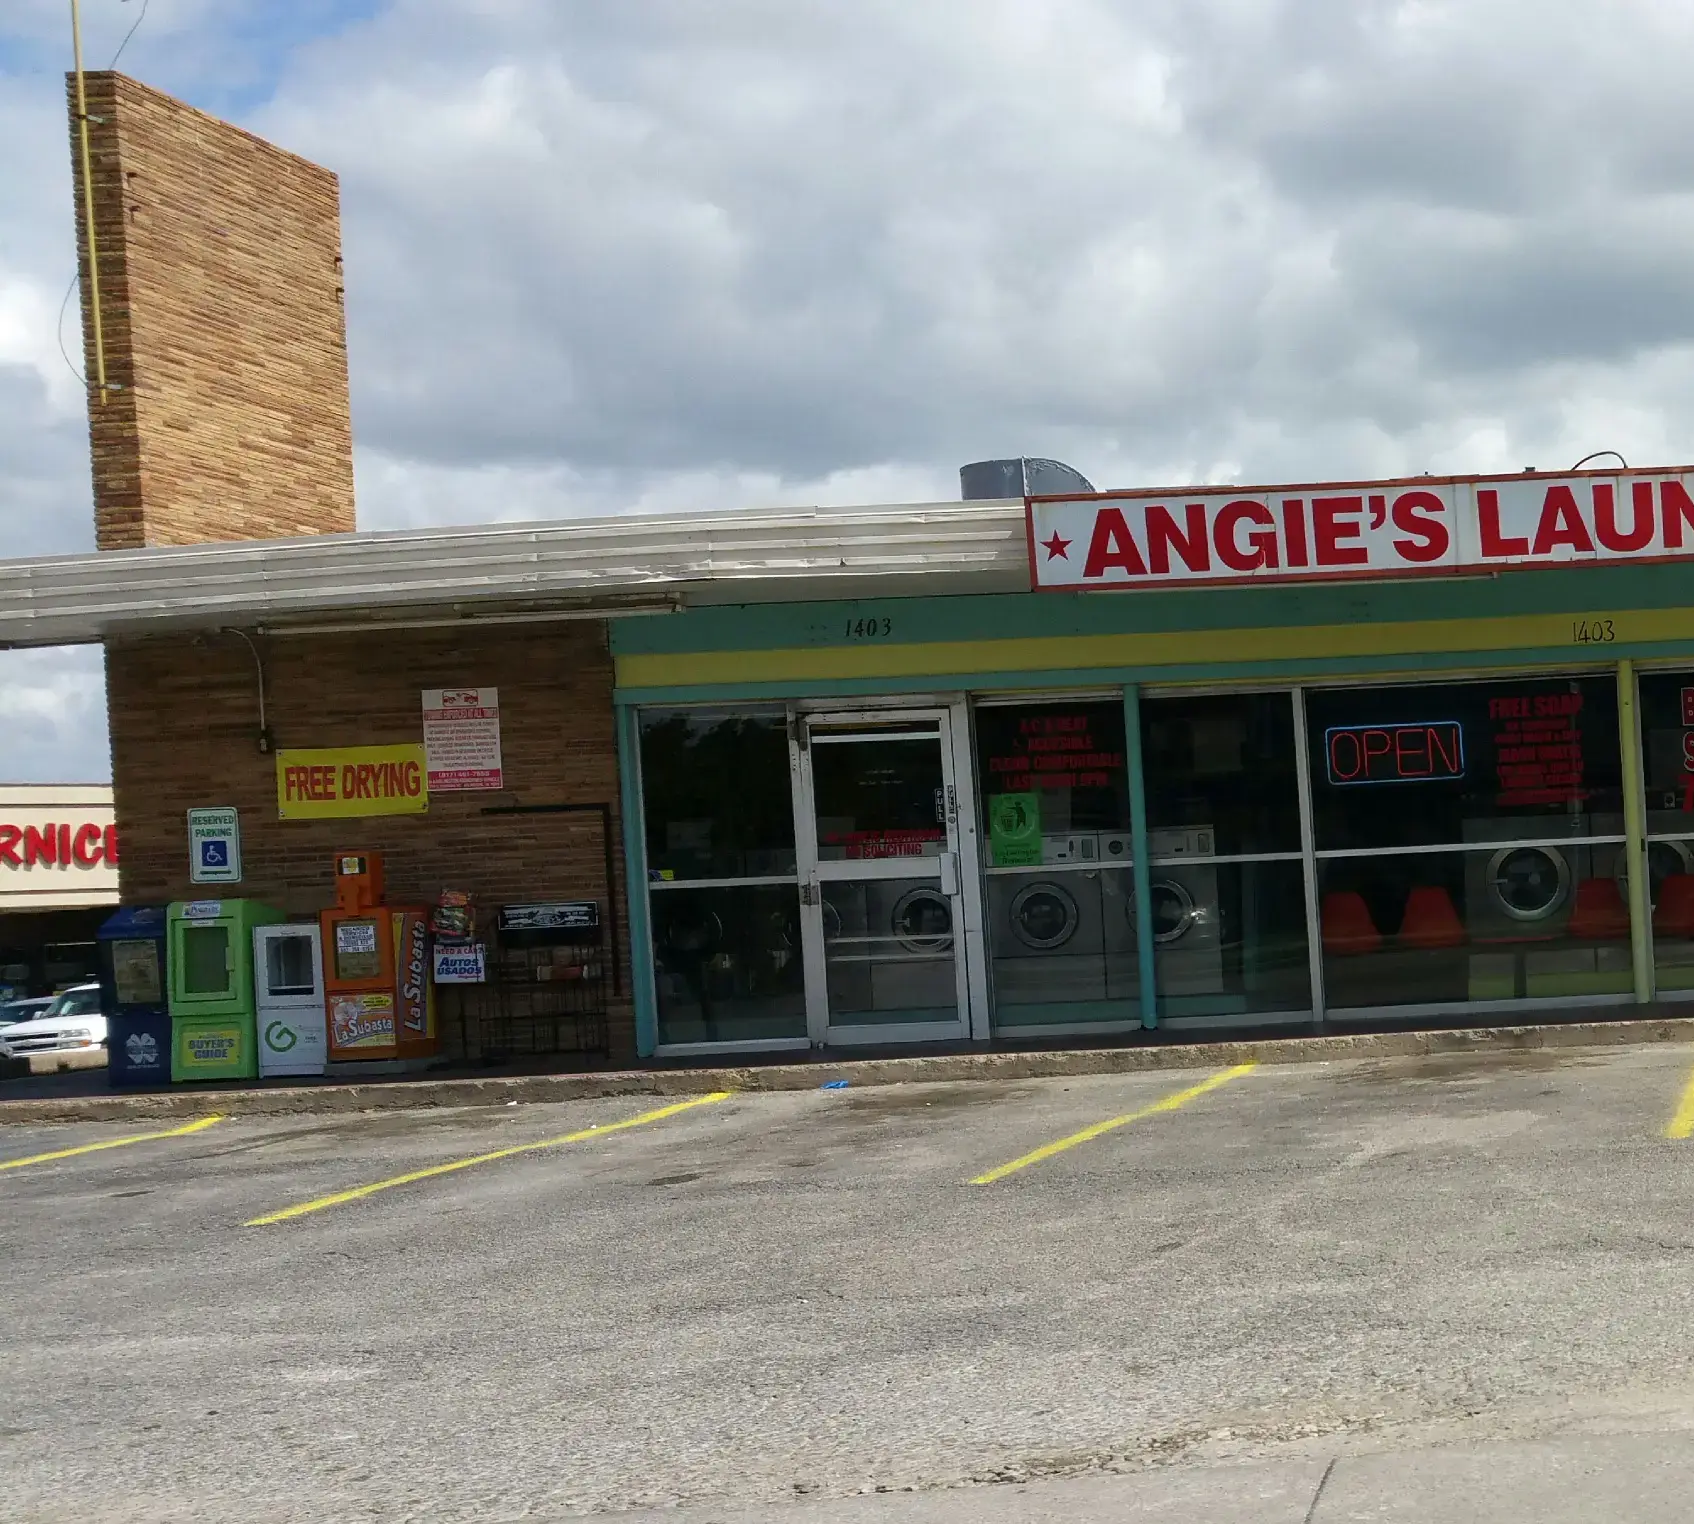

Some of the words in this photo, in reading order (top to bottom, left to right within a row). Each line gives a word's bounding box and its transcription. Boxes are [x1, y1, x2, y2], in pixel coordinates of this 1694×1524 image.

[1084, 491, 1449, 578] ANGIE'S
[846, 617, 892, 638] 1403
[1573, 620, 1615, 643] 1403
[1331, 728, 1459, 780] OPEN
[285, 765, 336, 801] FREE
[342, 761, 421, 799] DRYING
[192, 815, 235, 826] RESERVED
[195, 828, 233, 837] PARKING
[403, 920, 425, 1004] Subasta
[437, 966, 482, 976] USADOS
[439, 957, 479, 967] AUTOS
[404, 1006, 422, 1032] La
[334, 1022, 348, 1043] La
[348, 1018, 393, 1037] Subasta
[188, 1038, 235, 1050] BUYER'S
[194, 1049, 228, 1060] GUIDE
